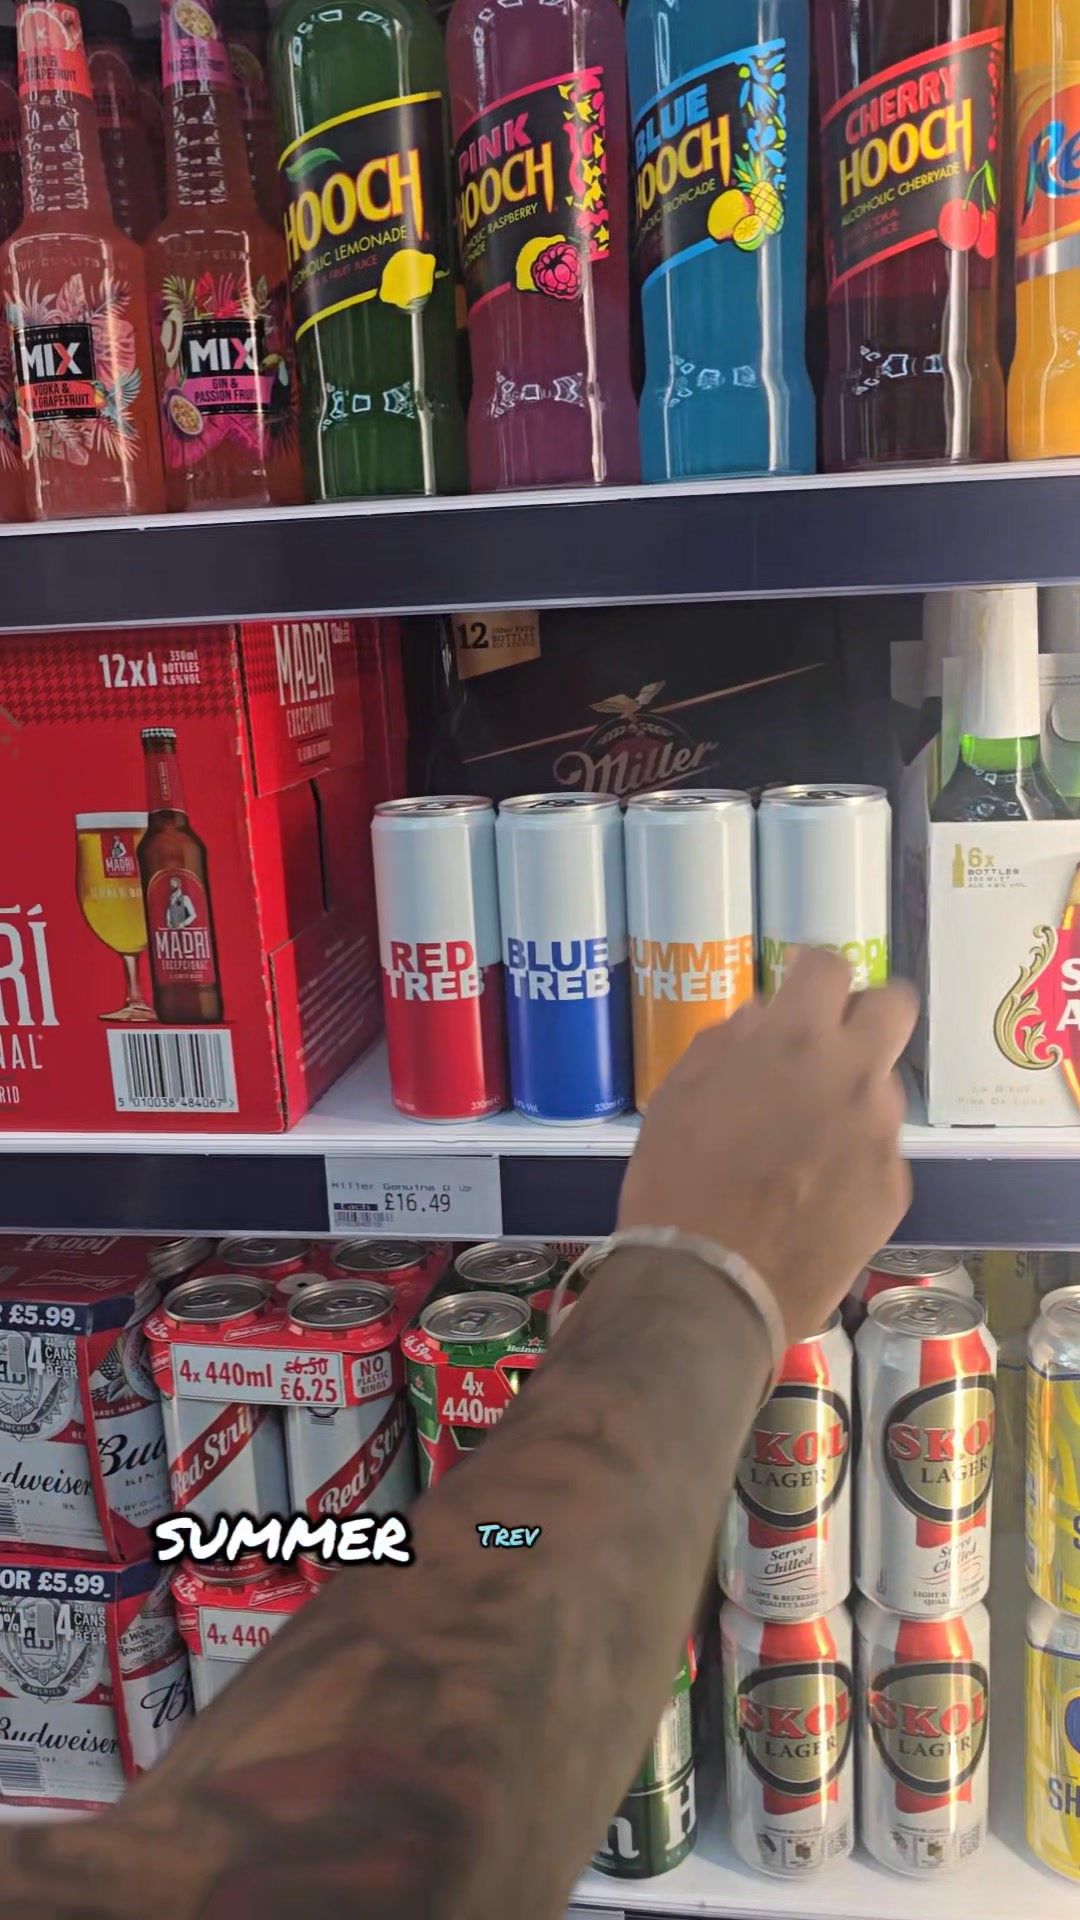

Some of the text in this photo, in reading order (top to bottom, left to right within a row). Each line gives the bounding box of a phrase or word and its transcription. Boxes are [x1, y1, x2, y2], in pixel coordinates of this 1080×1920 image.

[845, 64, 960, 144] CHERRY
[635, 83, 709, 168] BLUE
[459, 113, 531, 184] PINK
[839, 98, 972, 207] HOOCH
[636, 114, 731, 222] HOOCH
[1022, 120, 1080, 226] Re
[456, 142, 554, 236] HOOCH
[662, 178, 716, 214] TROPICADE
[842, 162, 960, 225] ALCOHOLIC CHERRYADE
[284, 149, 424, 271] HOOCH
[487, 202, 538, 234] RASPBERRY
[335, 225, 407, 261] LEMONADE
[21, 342, 82, 377] MIX
[188, 337, 259, 372] MIX
[34, 383, 69, 396] VODKA &
[194, 390, 232, 403] PASSION
[212, 378, 238, 389] GIN &
[38, 394, 89, 407] GRAPEFRUIT
[457, 621, 489, 649] 12
[98, 650, 198, 688] 12x 330ml
[162, 662, 200, 674] BOTTLES
[553, 741, 720, 795] Miller
[968, 847, 994, 868] 6x
[968, 868, 1020, 876] BOTTLES
[390, 941, 474, 972] RED
[507, 937, 609, 972] BLUE
[385, 968, 486, 1001] TREB
[509, 966, 611, 1001] TREB
[633, 967, 736, 1002] TREB
[118, 1097, 223, 1108] 5 010038 484067
[384, 1192, 451, 1213] £16.49
[9, 1304, 76, 1328] £5.99
[28, 1336, 77, 1375] 4 CANS
[360, 1356, 384, 1376] NO
[46, 1365, 79, 1379] BEER
[180, 1359, 274, 1388] 4x 440ml
[357, 1369, 390, 1387] PLASTIC
[461, 1371, 484, 1397] 4x
[281, 1377, 338, 1403] £6.25
[361, 1381, 387, 1394] RINGS
[171, 1453, 205, 1505] Red
[751, 1467, 828, 1489] LAGER
[921, 1455, 988, 1484] LAGER
[318, 1460, 371, 1515] Red
[764, 1553, 814, 1575] Chilled
[770, 1545, 807, 1561] Serve
[37, 1571, 105, 1595] £5.99
[913, 1590, 939, 1598] LIGHT
[56, 1603, 106, 1641] 4 CANS
[207, 1622, 228, 1646] 4x
[74, 1631, 107, 1644] BEER
[739, 1692, 850, 1739] SKOL
[866, 1692, 985, 1738] SKOL
[765, 1735, 837, 1759] LAGER
